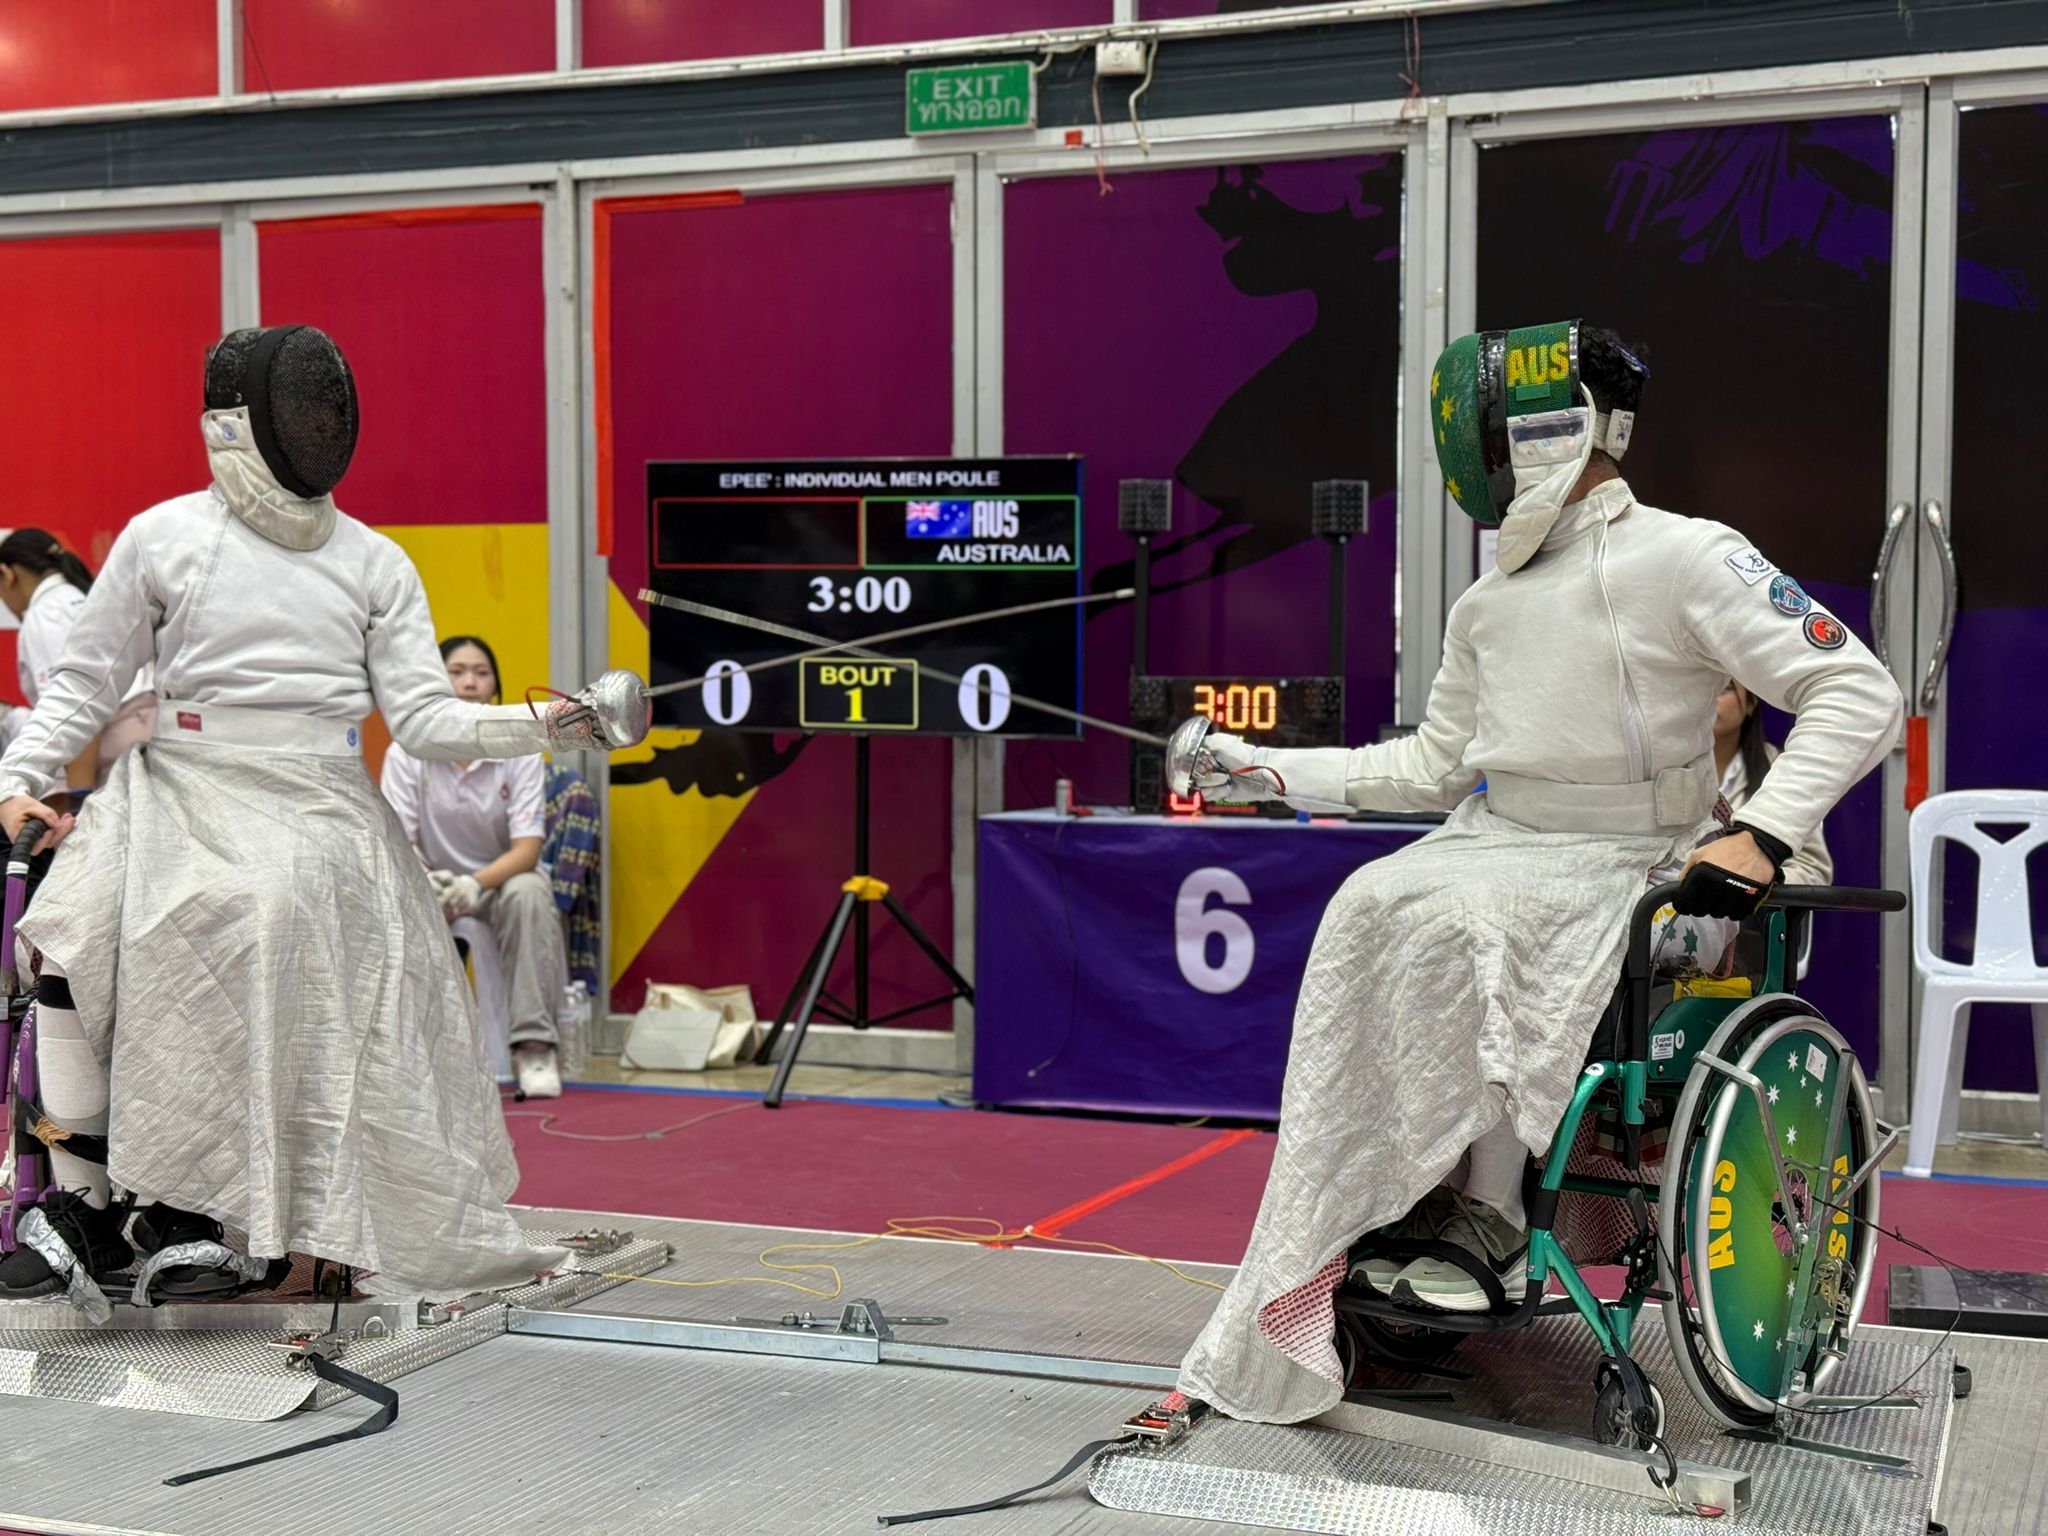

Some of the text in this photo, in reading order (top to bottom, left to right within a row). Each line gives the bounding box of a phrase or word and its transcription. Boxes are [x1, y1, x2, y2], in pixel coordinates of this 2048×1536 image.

[932, 75, 1004, 100] EXIT
[918, 97, 1021, 123] ทางออก
[1506, 342, 1570, 387] AUS
[784, 472, 886, 487] INDIVIDUAL
[890, 472, 932, 486] MEN
[936, 470, 1000, 486] POULE
[972, 500, 1019, 538] AUS
[937, 544, 1071, 563] AUSTRALIA
[807, 576, 912, 613] 3:00
[701, 659, 752, 726] 0
[820, 666, 896, 686] BOUT
[844, 687, 867, 723] 1
[958, 663, 1012, 732] 0
[1194, 684, 1276, 730] 3:00
[1175, 866, 1255, 994] 6
[1708, 1159, 1737, 1271] AUS
